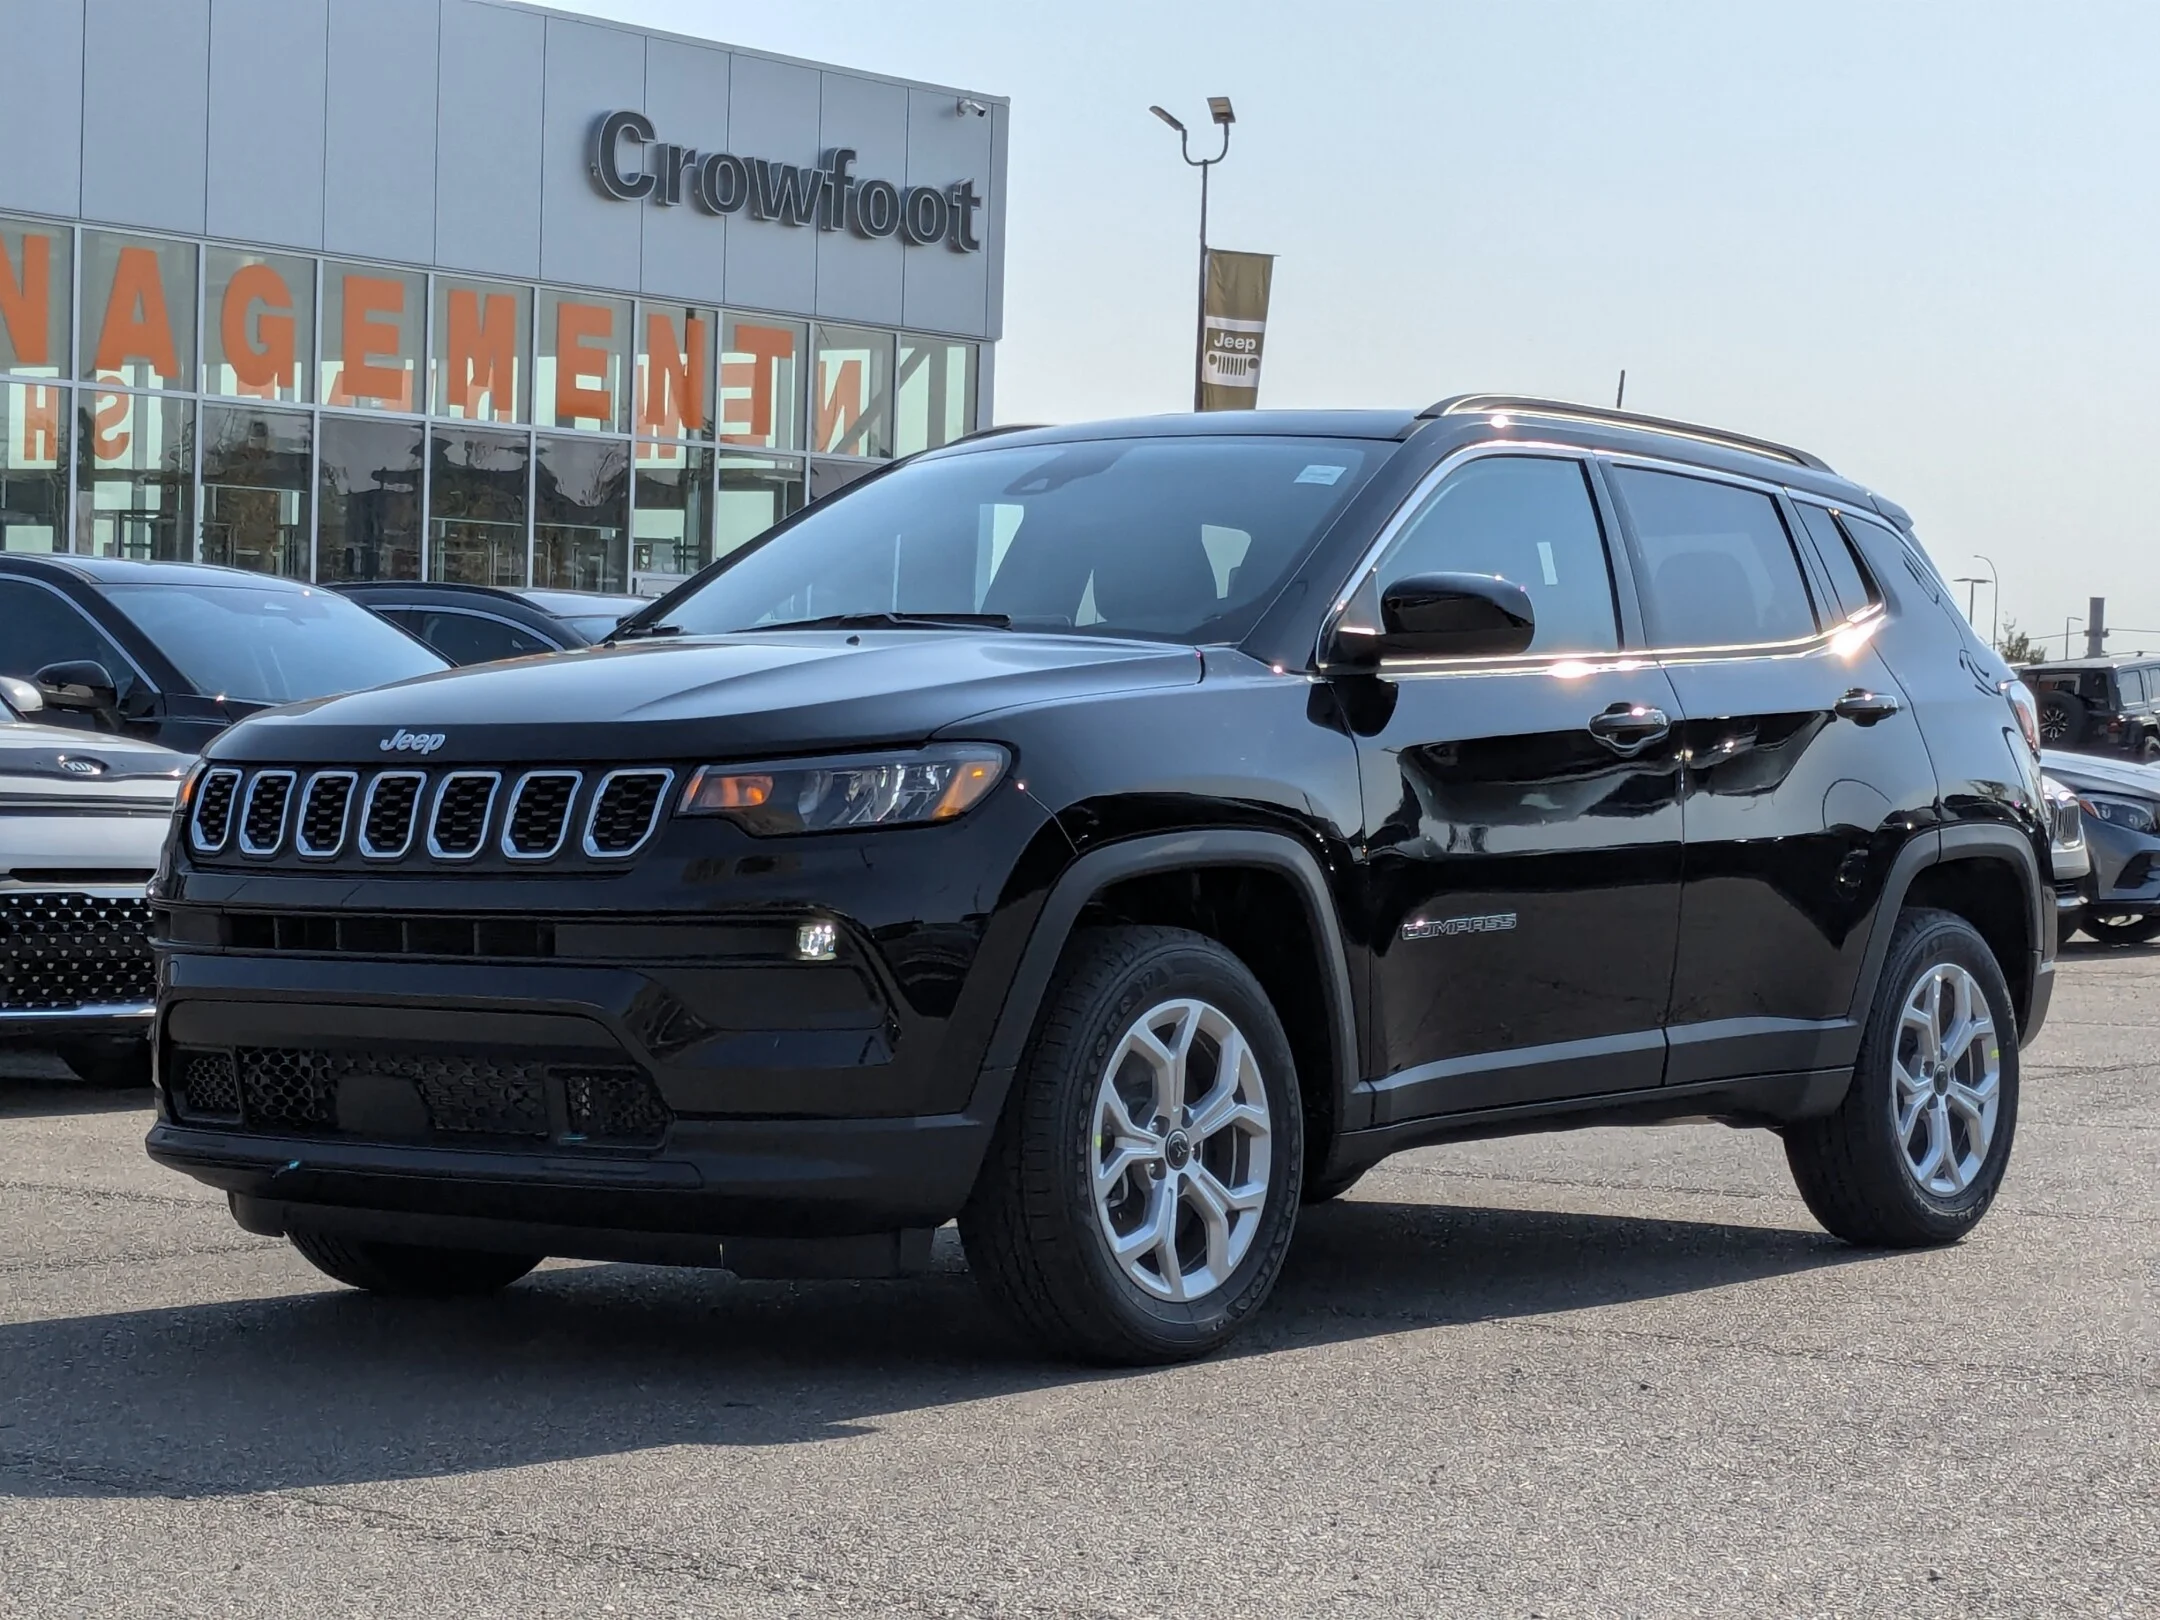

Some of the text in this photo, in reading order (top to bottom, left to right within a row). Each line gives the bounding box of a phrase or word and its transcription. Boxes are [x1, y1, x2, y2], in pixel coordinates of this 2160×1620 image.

[594, 108, 982, 254] Crowfoot
[1213, 332, 1257, 354] Jeep
[379, 728, 446, 756] Jeep
[1401, 912, 1517, 940] COMPASS
